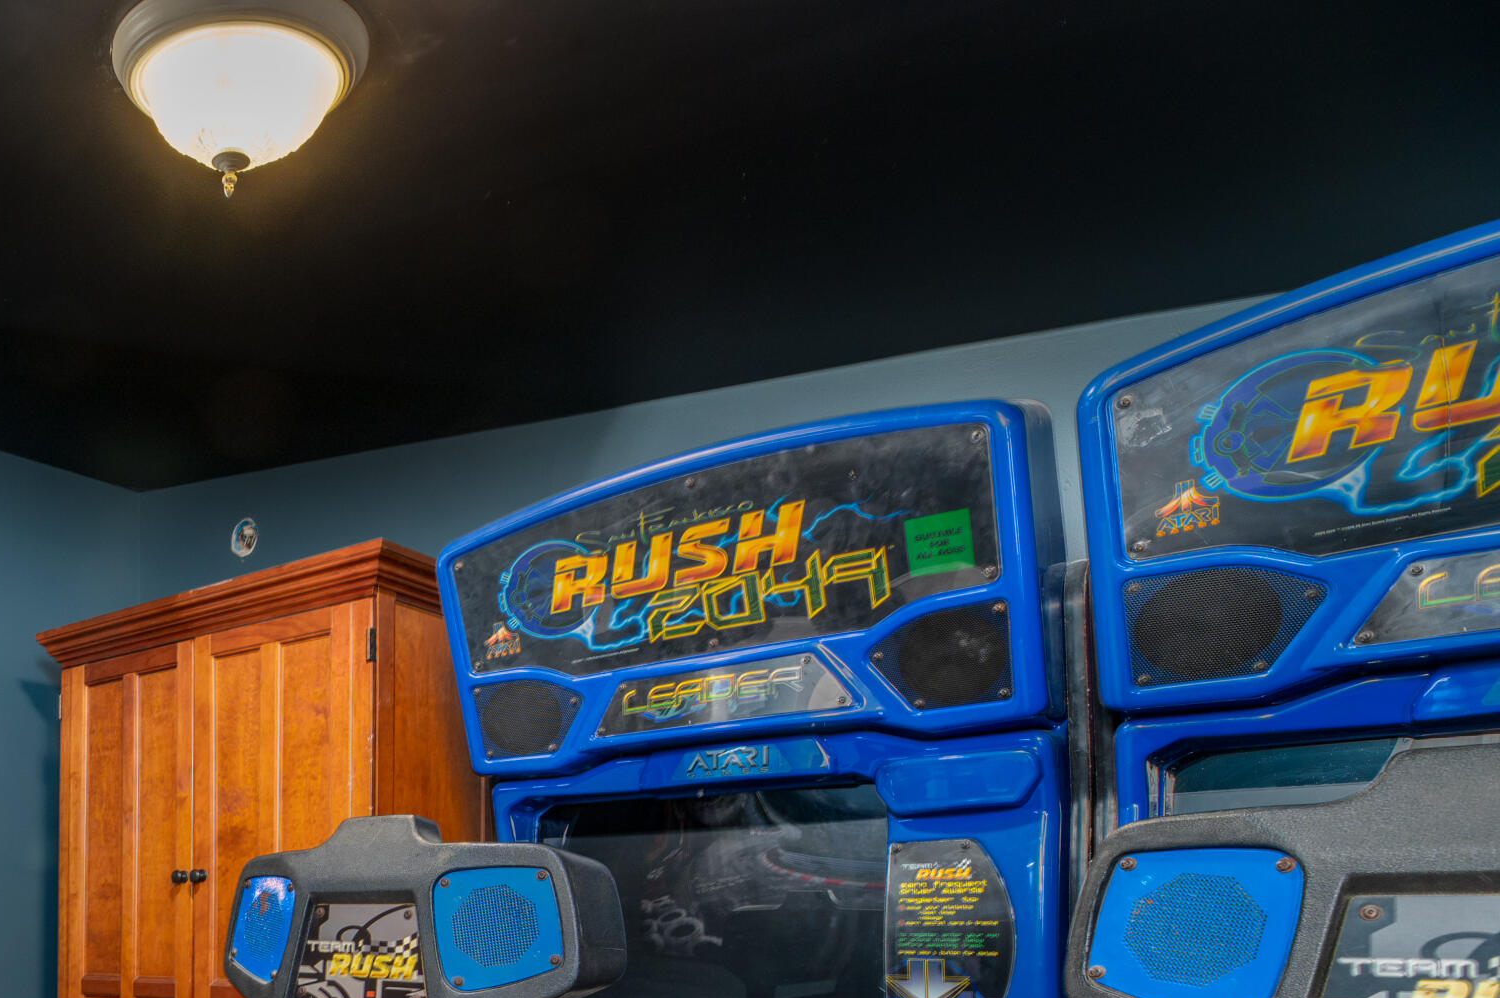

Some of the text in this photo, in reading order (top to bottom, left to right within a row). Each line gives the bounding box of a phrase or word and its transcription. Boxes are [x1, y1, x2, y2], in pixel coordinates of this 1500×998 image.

[550, 499, 806, 614] RUSH
[623, 665, 804, 716] LEADER
[686, 745, 770, 772] ATARI
[916, 866, 972, 880] RUSH
[307, 940, 356, 953] TEAM
[329, 952, 418, 980] RUSH
[1336, 957, 1480, 978] TEAM
